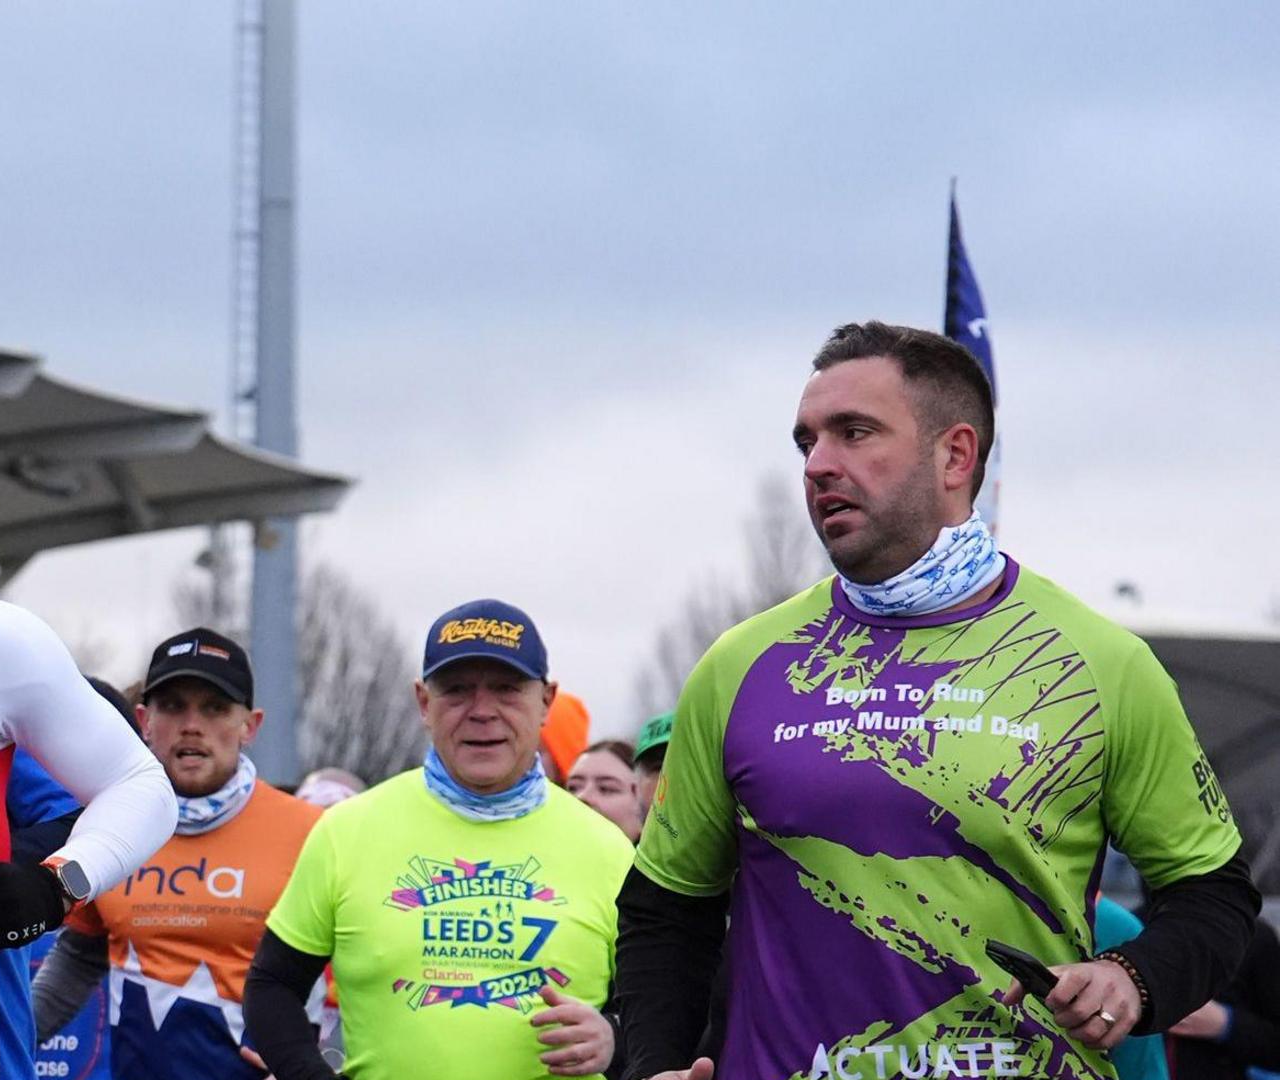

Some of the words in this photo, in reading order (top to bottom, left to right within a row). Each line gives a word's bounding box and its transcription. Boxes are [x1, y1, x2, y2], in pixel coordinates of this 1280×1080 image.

[825, 686, 886, 705] Born
[894, 684, 924, 702] To
[934, 684, 985, 703] Run
[773, 722, 808, 742] for
[812, 717, 852, 736] my
[857, 712, 925, 731] Mum
[933, 714, 983, 733] and
[991, 716, 1039, 741] Dad
[424, 878, 528, 905] FINISHER
[7, 920, 46, 941] OXEN
[423, 918, 515, 944] LEEDS
[519, 916, 560, 962] 7
[422, 946, 514, 960] MARATHON
[423, 968, 474, 981] Clarion
[488, 972, 542, 999] 2024
